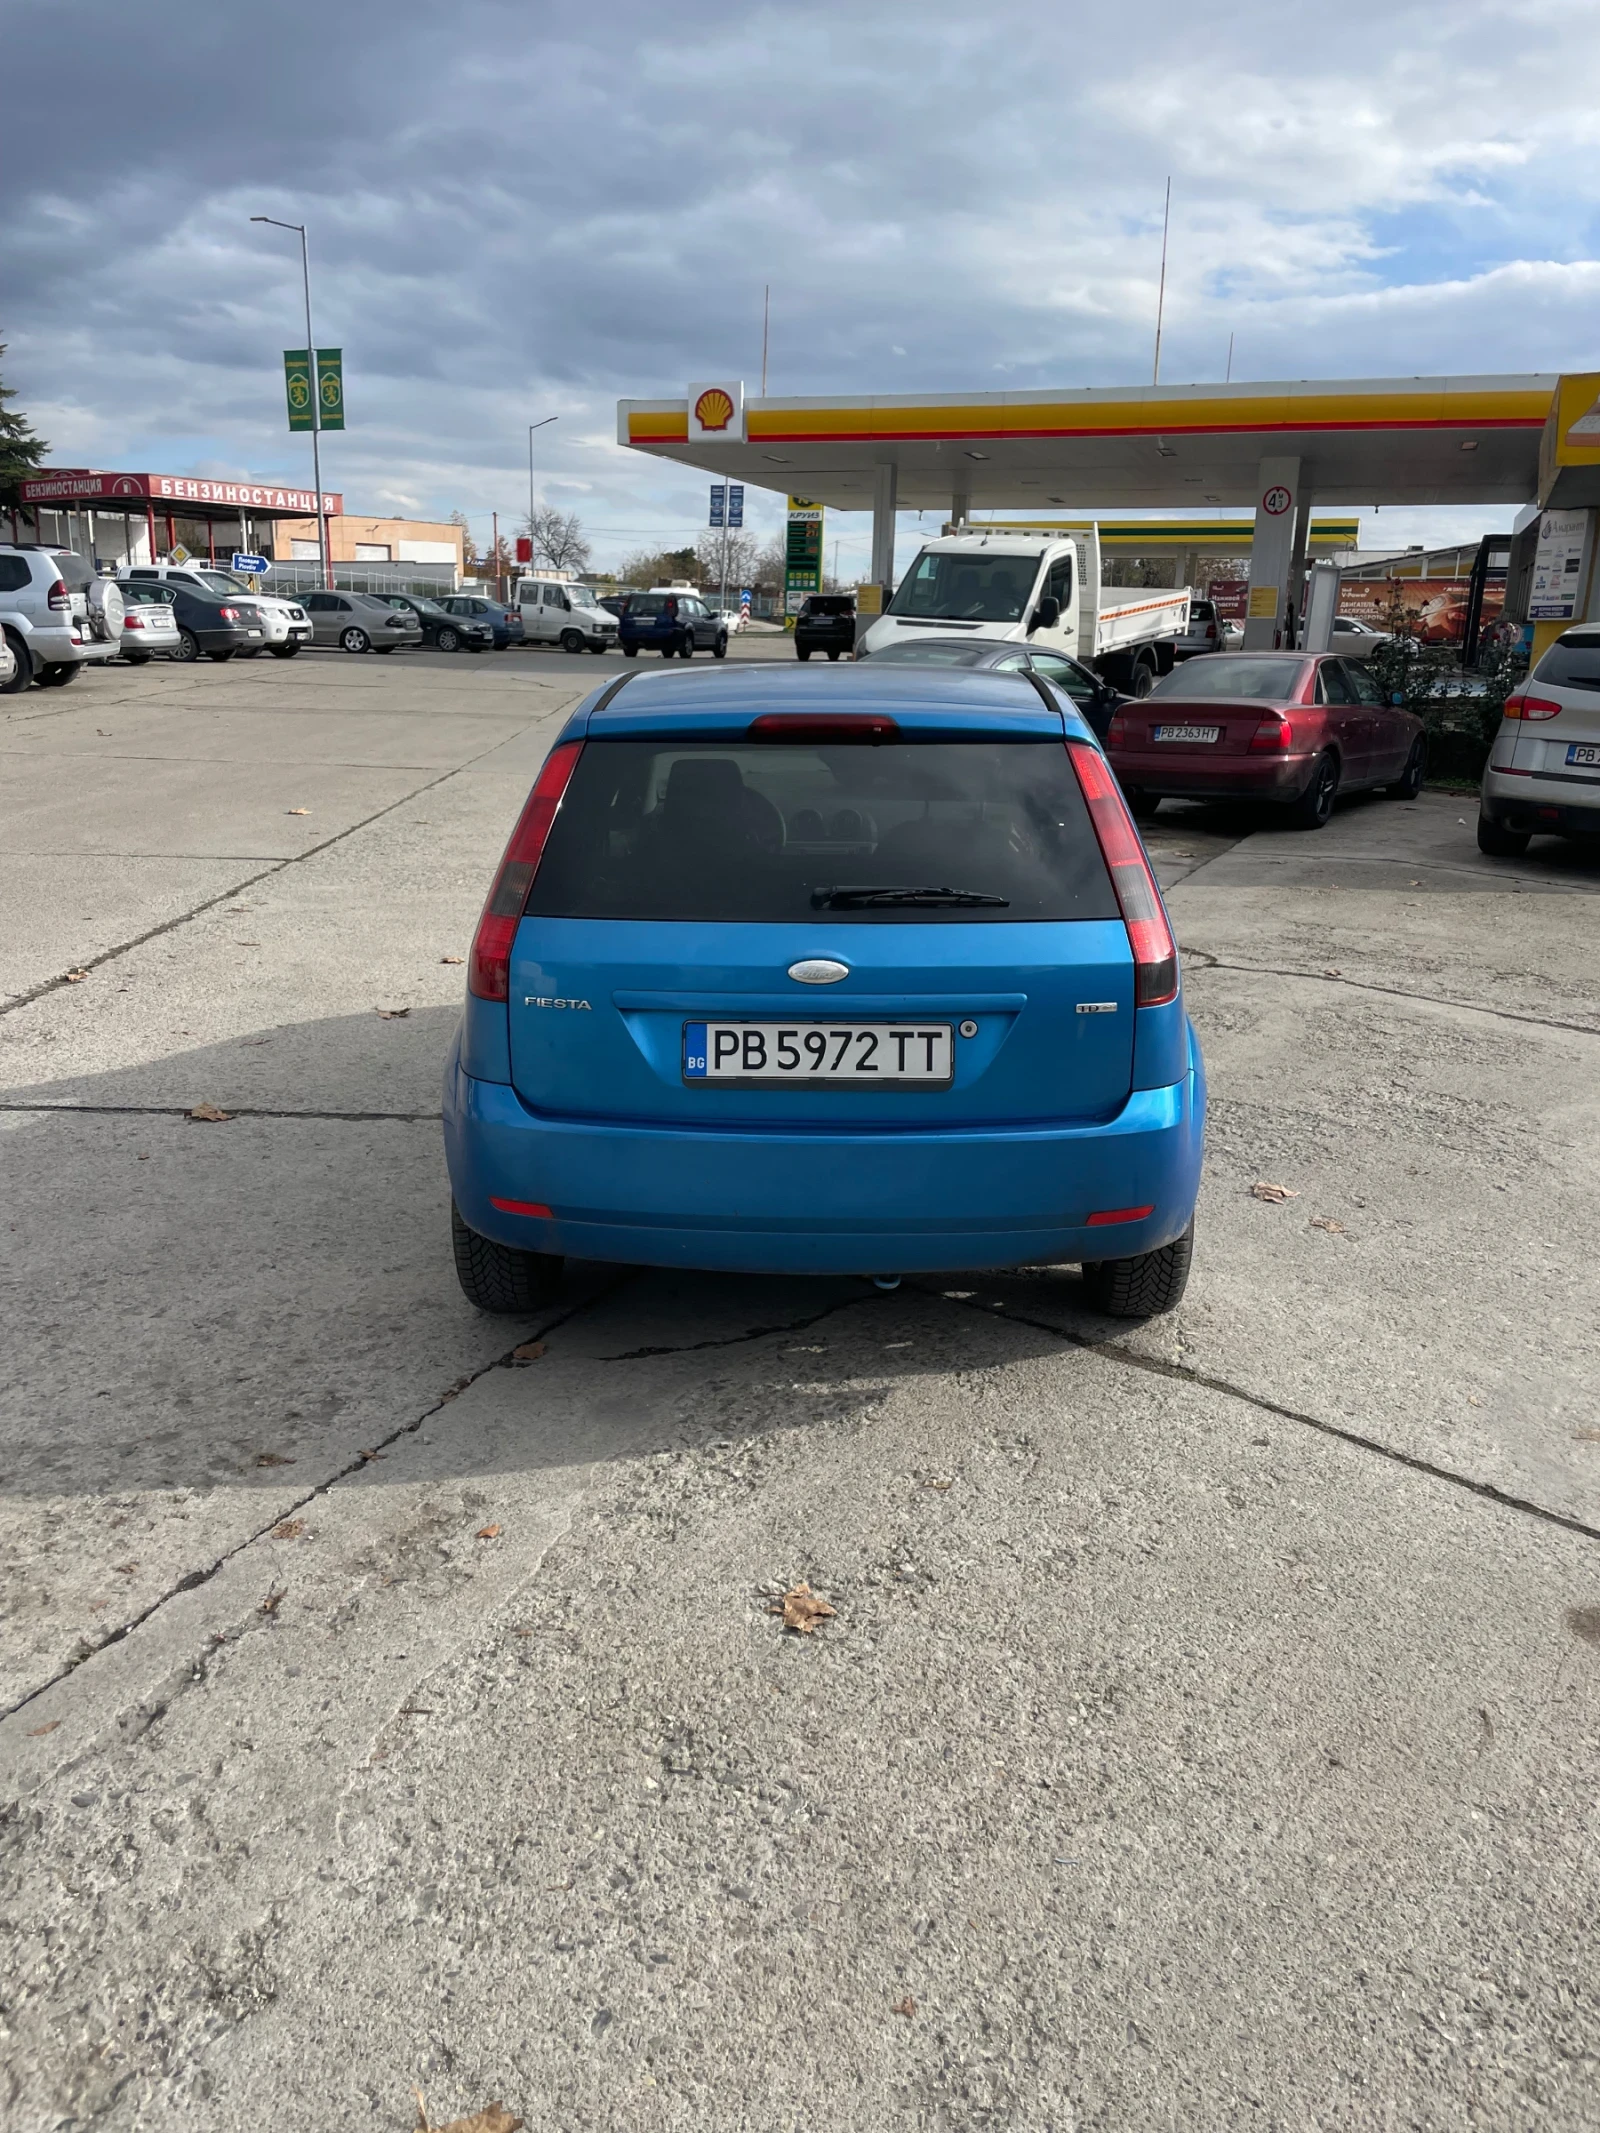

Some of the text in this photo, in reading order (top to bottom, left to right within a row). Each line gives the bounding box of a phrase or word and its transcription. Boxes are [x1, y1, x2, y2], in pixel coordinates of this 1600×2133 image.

[25, 478, 102, 498] БЕНЗИНОСТАНЦИЯ
[160, 479, 334, 512] БЕНЗИНОСТАНЦИЯ
[1268, 493, 1277, 508] 4
[789, 511, 820, 519] КРУИЗ
[1161, 728, 1217, 739] PB 2363 HT
[1576, 748, 1595, 762] PB
[524, 996, 592, 1010] FIESTA
[714, 1030, 943, 1071] PB 5972 TT
[687, 1056, 705, 1069] BG
